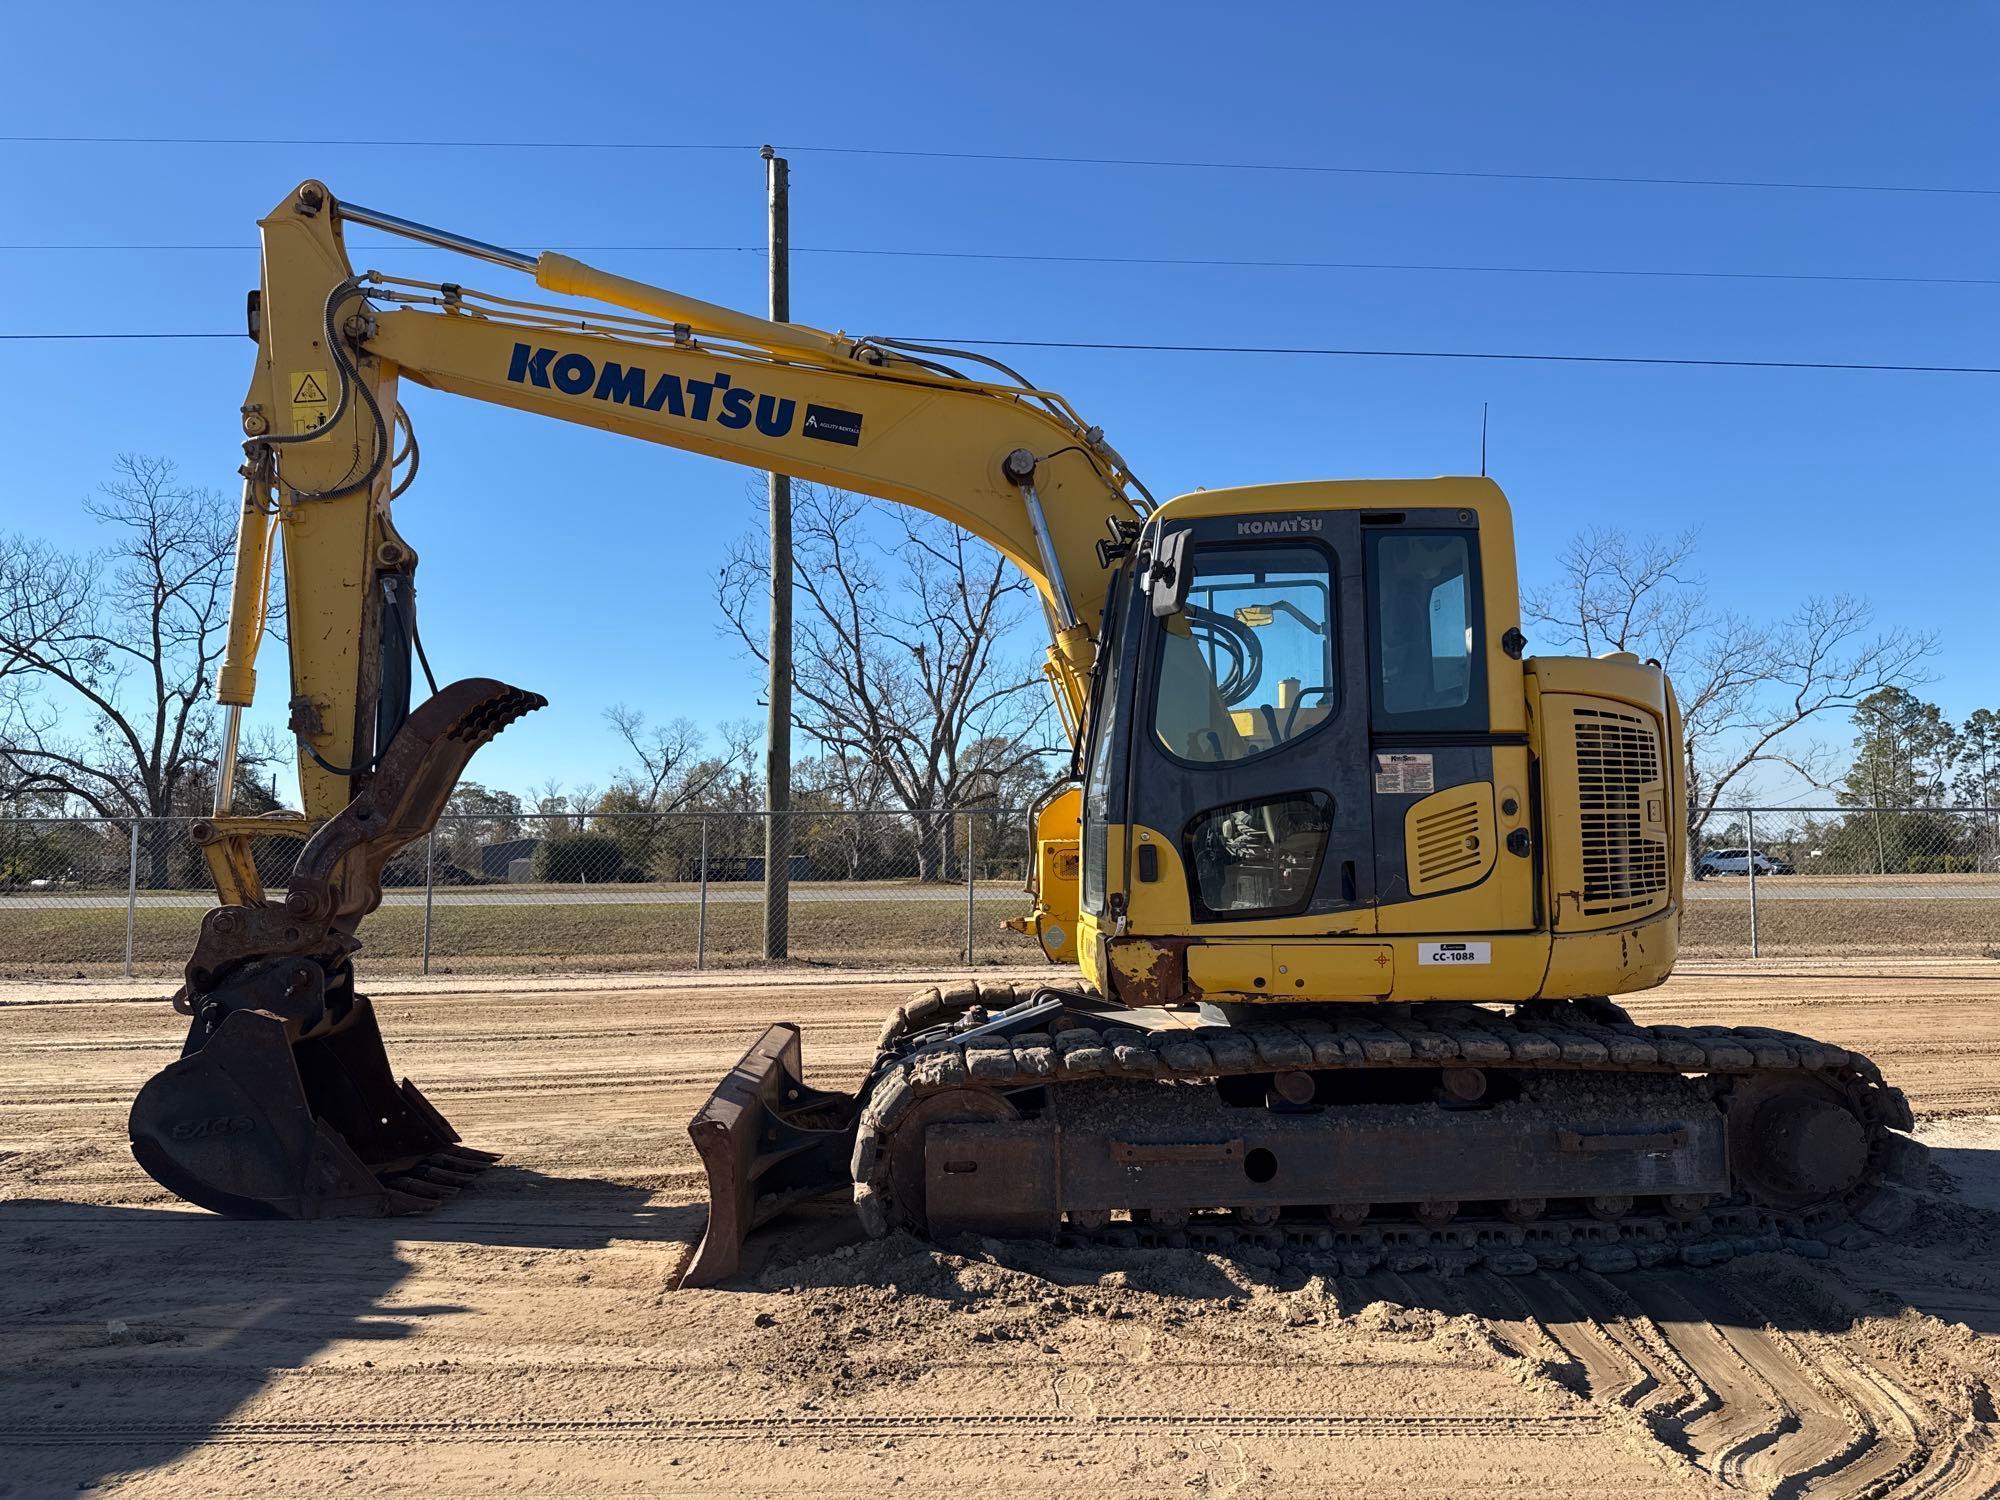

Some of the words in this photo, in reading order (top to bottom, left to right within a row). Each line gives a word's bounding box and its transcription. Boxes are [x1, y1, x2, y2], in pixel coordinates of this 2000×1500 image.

[507, 342, 797, 437] KOMATSU
[820, 422, 838, 430] AGILITY
[839, 425, 860, 434] RENTALS
[1237, 516, 1322, 534] KOMATSU
[1432, 952, 1475, 961] CC-1088
